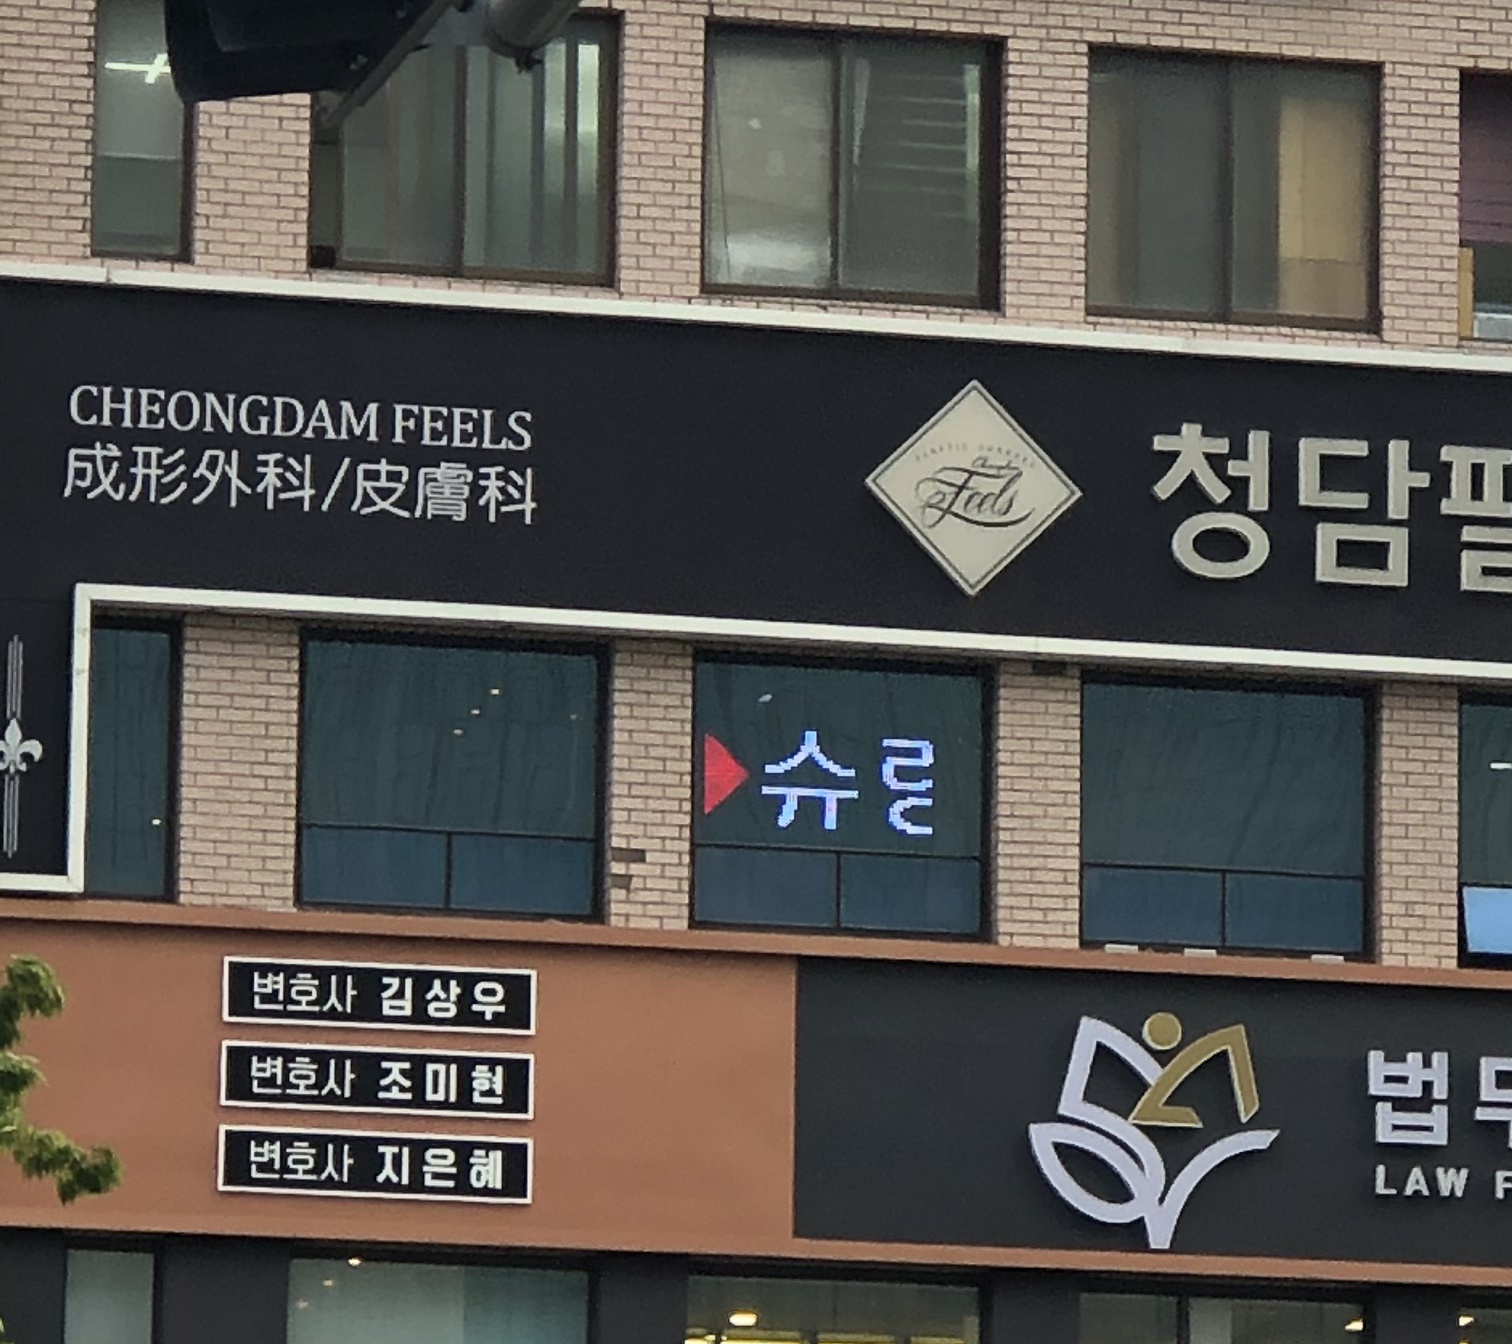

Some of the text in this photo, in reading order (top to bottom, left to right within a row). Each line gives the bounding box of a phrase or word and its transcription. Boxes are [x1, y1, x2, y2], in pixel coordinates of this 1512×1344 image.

[69, 385, 534, 451] CHEONGDAM FEELS
[63, 442, 538, 525] 成形外科/皮膚科
[252, 971, 506, 1022] 변호사 김상우
[250, 1055, 505, 1106] 변호사 조미현
[249, 1139, 503, 1191] 변호사 지은혜
[1375, 1164, 1469, 1199] LAW
